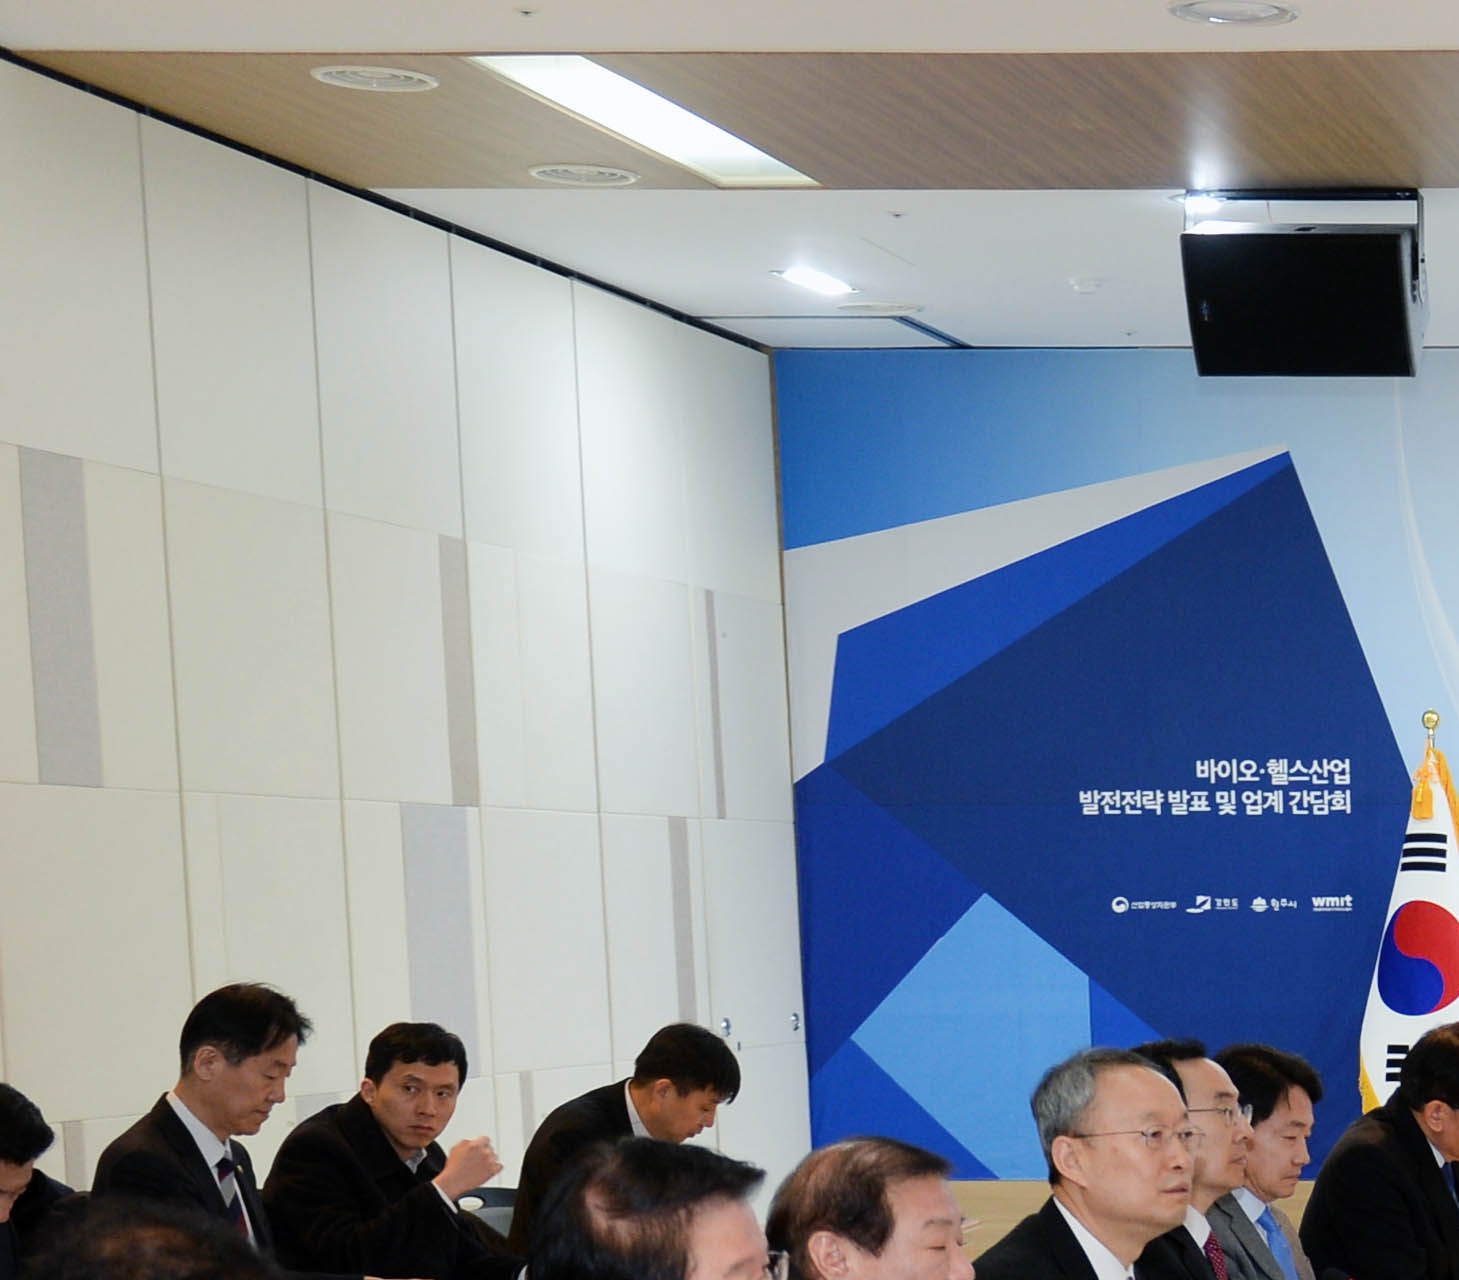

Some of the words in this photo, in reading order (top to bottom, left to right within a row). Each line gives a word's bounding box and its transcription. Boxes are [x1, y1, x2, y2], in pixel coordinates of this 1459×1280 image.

[1195, 758, 1351, 785] 바이오·헬스산업
[1079, 789, 1164, 815] 발전전략
[1167, 789, 1211, 815] 발표
[1215, 789, 1237, 816] 및
[1241, 789, 1284, 816] 업계
[1289, 789, 1351, 815] 간담회
[1311, 895, 1354, 907] wmit
